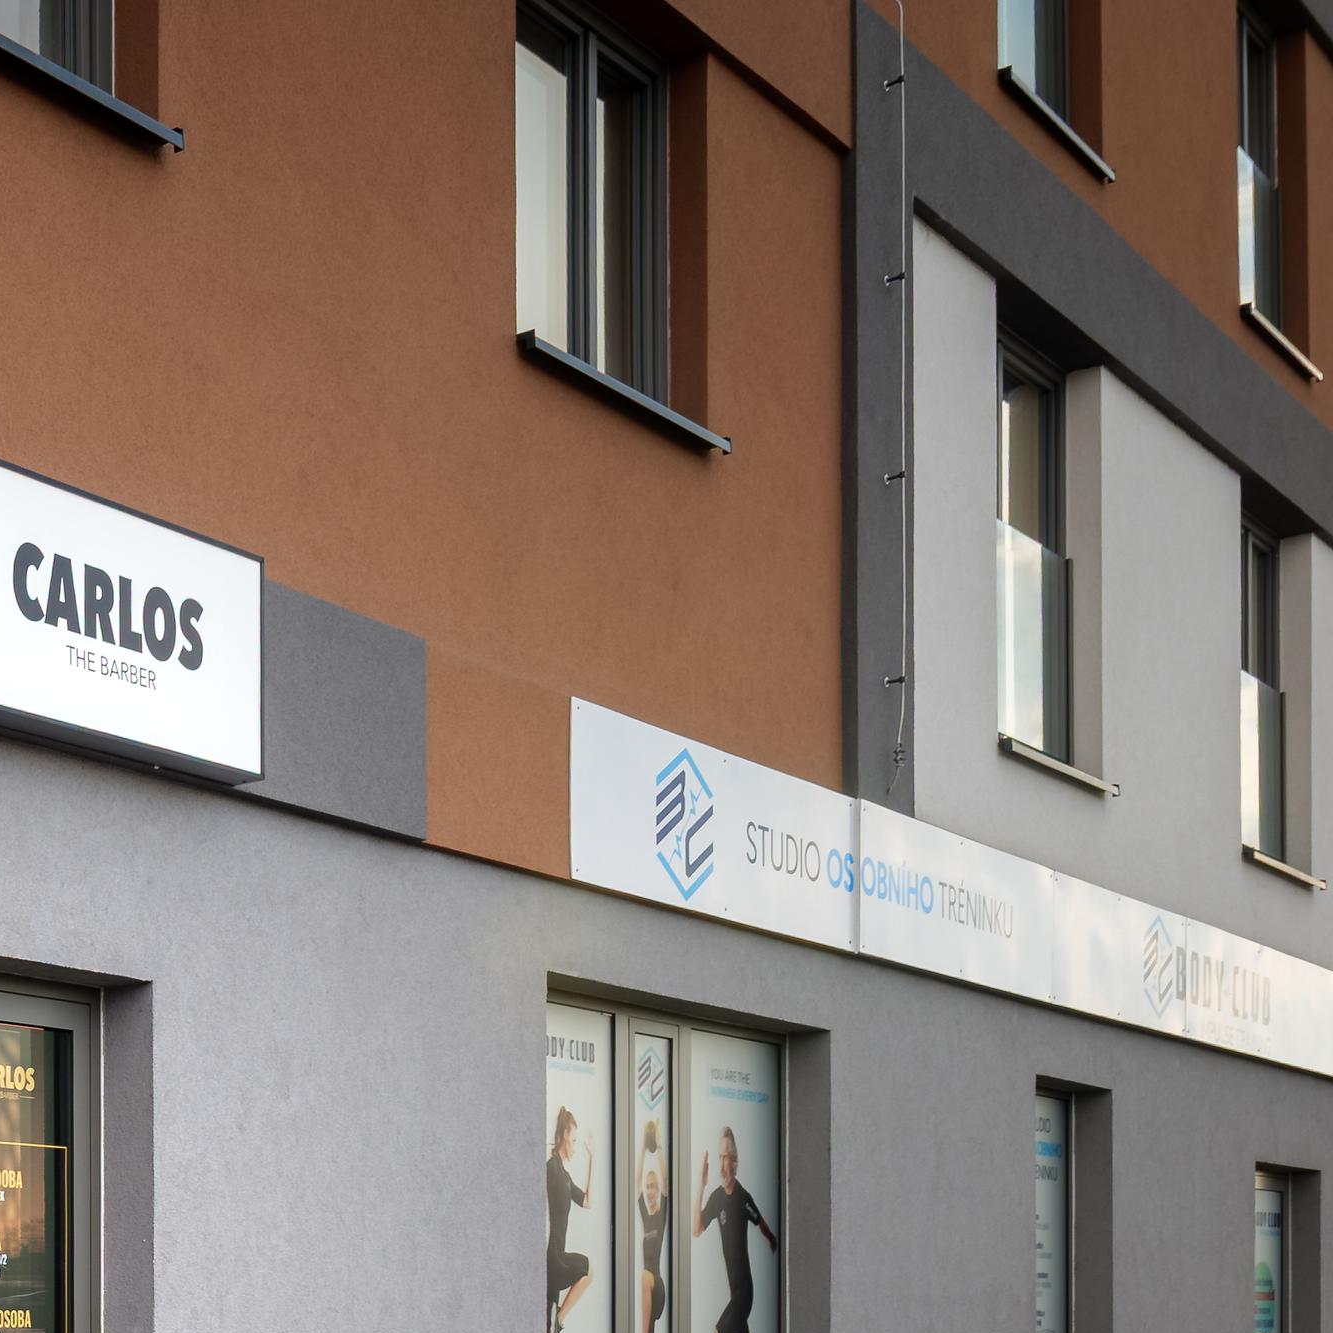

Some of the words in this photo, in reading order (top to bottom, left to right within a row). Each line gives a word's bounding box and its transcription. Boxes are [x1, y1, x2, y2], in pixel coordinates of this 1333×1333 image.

[13, 542, 203, 671] CARLOS
[66, 644, 96, 673] THE
[100, 655, 157, 691] BARBER
[746, 821, 821, 882] STUDIO
[938, 880, 1014, 939] TRÉNINKU
[1176, 946, 1224, 1012] BODY
[1232, 965, 1271, 1026] CLUB
[570, 1039, 596, 1063] CLUB
